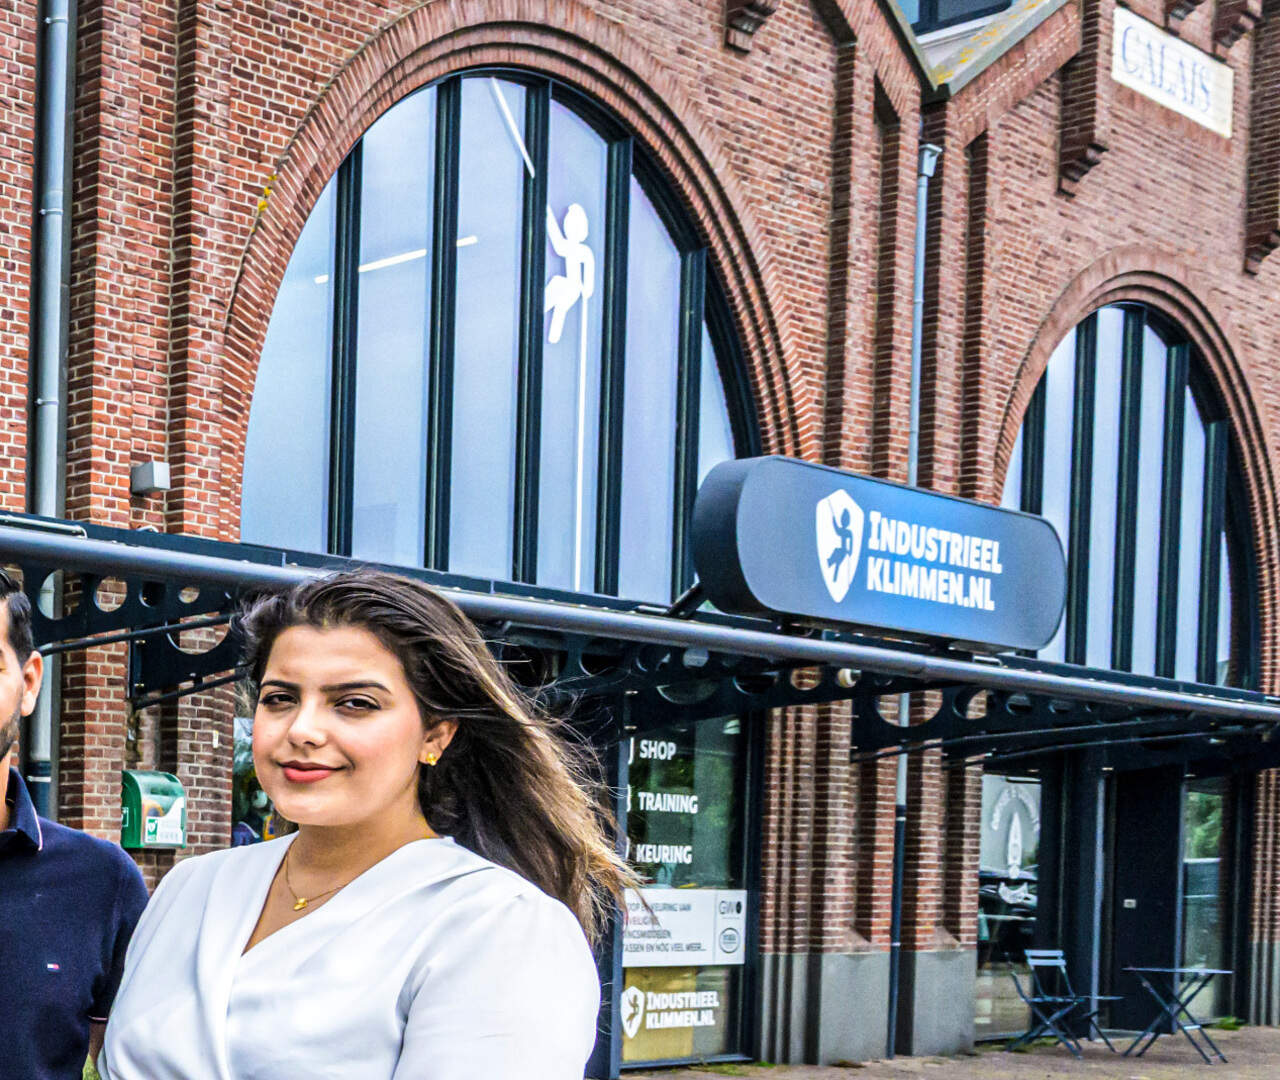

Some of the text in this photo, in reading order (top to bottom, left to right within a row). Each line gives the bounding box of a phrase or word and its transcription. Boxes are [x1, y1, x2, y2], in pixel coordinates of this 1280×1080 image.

[868, 510, 1003, 574] INDUSTRIEEL
[867, 556, 995, 611] KLIMMEN.NL
[639, 739, 677, 760] SHOP
[638, 791, 699, 814] TRAINING
[636, 843, 693, 864] KEURING
[646, 990, 720, 1010] INDUSTRIEEL
[645, 1009, 716, 1029] KLIMMEN.NL
